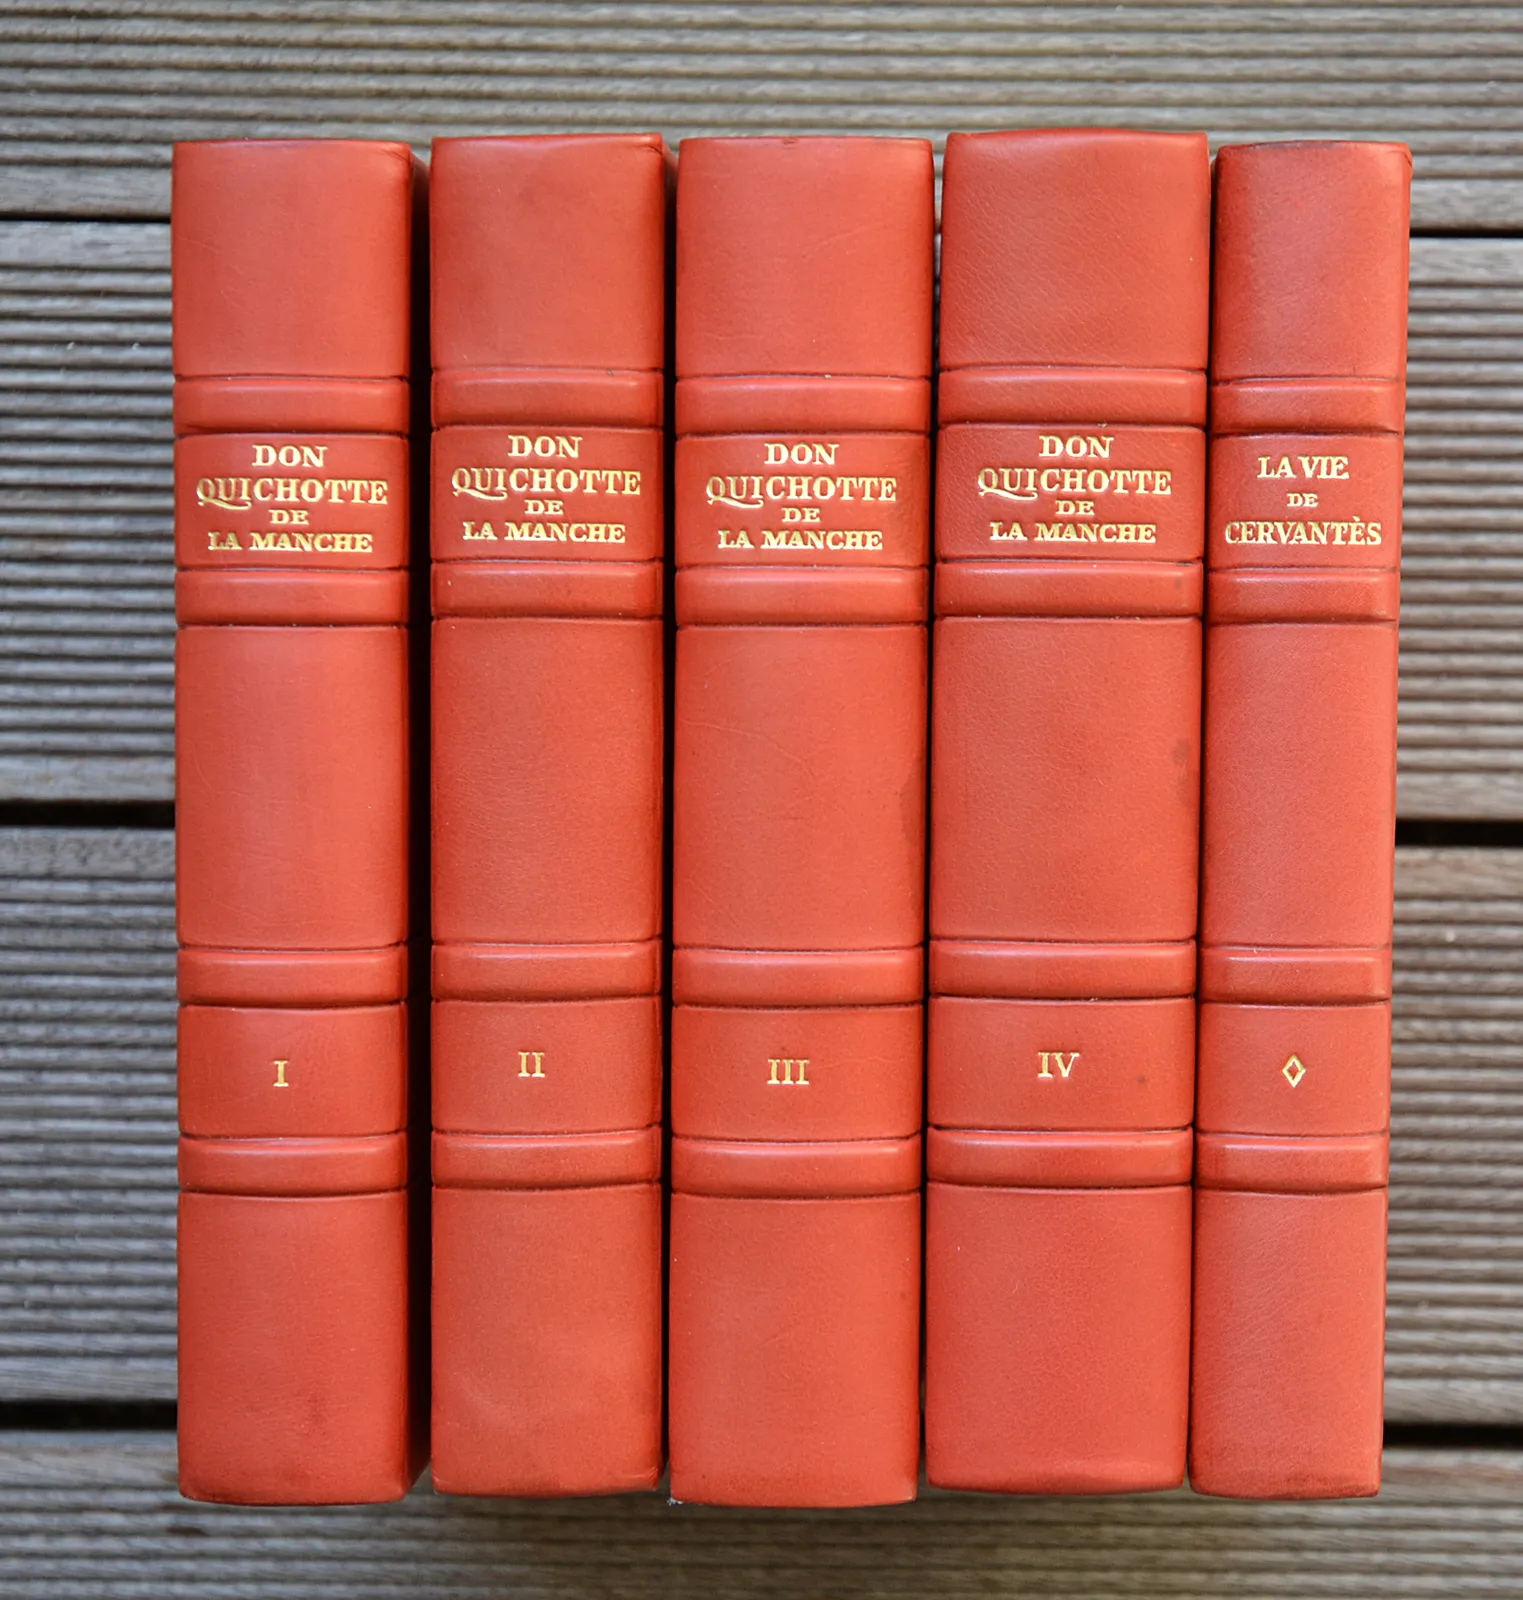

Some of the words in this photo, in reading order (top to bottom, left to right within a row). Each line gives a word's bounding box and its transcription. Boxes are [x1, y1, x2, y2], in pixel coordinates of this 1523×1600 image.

[252, 445, 327, 468] DON
[507, 435, 582, 459] DON
[764, 443, 839, 468] DON
[1038, 435, 1113, 460] DON
[1257, 456, 1297, 479] LA
[1298, 456, 1350, 480] VIE
[196, 477, 388, 509] QUICHOTTE
[451, 467, 641, 499] QUICHOTTE
[705, 475, 897, 509] QUICHOTTE
[976, 467, 1171, 502] QUICHOTTE
[523, 499, 563, 515] DE
[1054, 499, 1094, 516] DE
[1286, 493, 1318, 508] DE
[268, 509, 309, 525] DE
[780, 507, 820, 524] DE
[207, 532, 241, 551] LA
[249, 532, 373, 553] MANCHE
[462, 521, 497, 541] LA
[504, 522, 626, 544] MANCHE
[717, 530, 752, 549] LA
[760, 530, 883, 551] MANCHE
[988, 521, 1028, 541] LA
[1033, 522, 1156, 545] MANCHE
[1225, 516, 1382, 546] CERVANTÈS
[273, 1060, 289, 1087] I
[517, 1051, 546, 1078] II
[766, 1058, 810, 1086] III
[1037, 1051, 1080, 1079] IV
